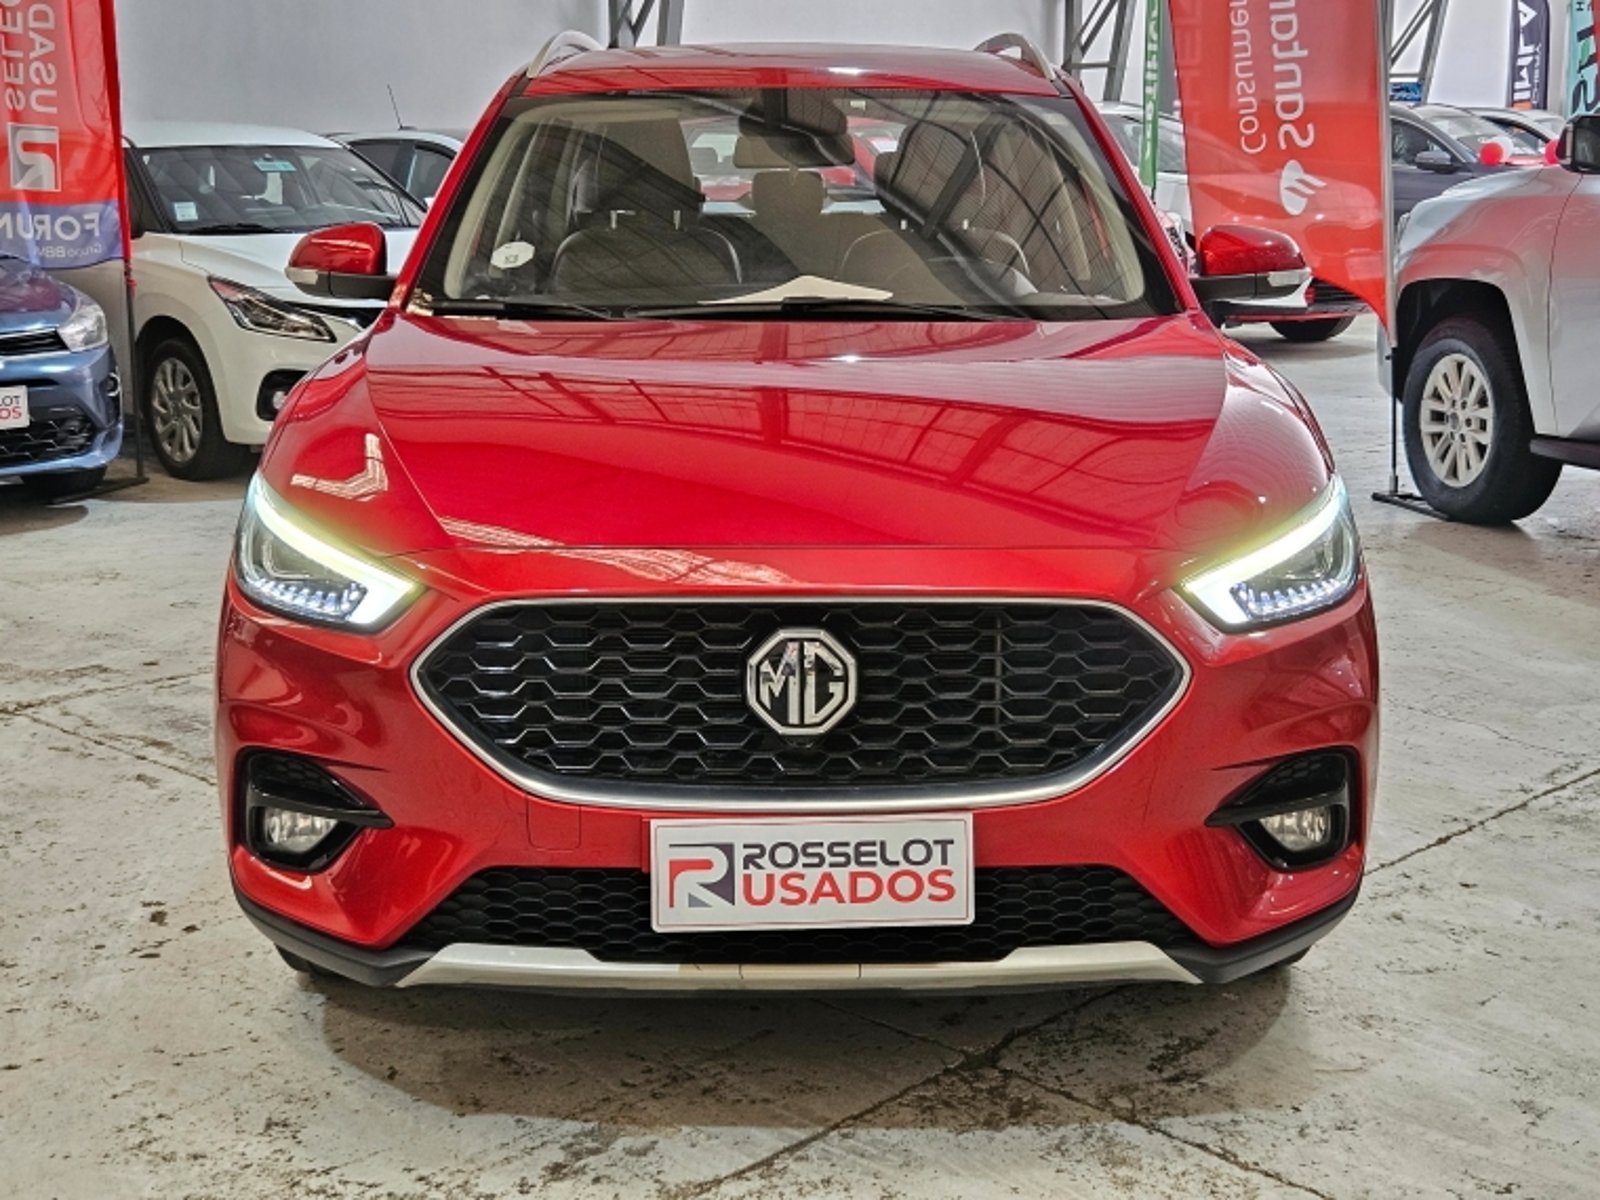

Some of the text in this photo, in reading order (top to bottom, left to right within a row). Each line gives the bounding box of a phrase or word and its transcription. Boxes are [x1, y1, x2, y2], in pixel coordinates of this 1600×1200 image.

[0, 395, 21, 407] OT
[760, 641, 845, 725] MG
[742, 839, 955, 870] ROSSELOT
[743, 869, 956, 906] USADOS
